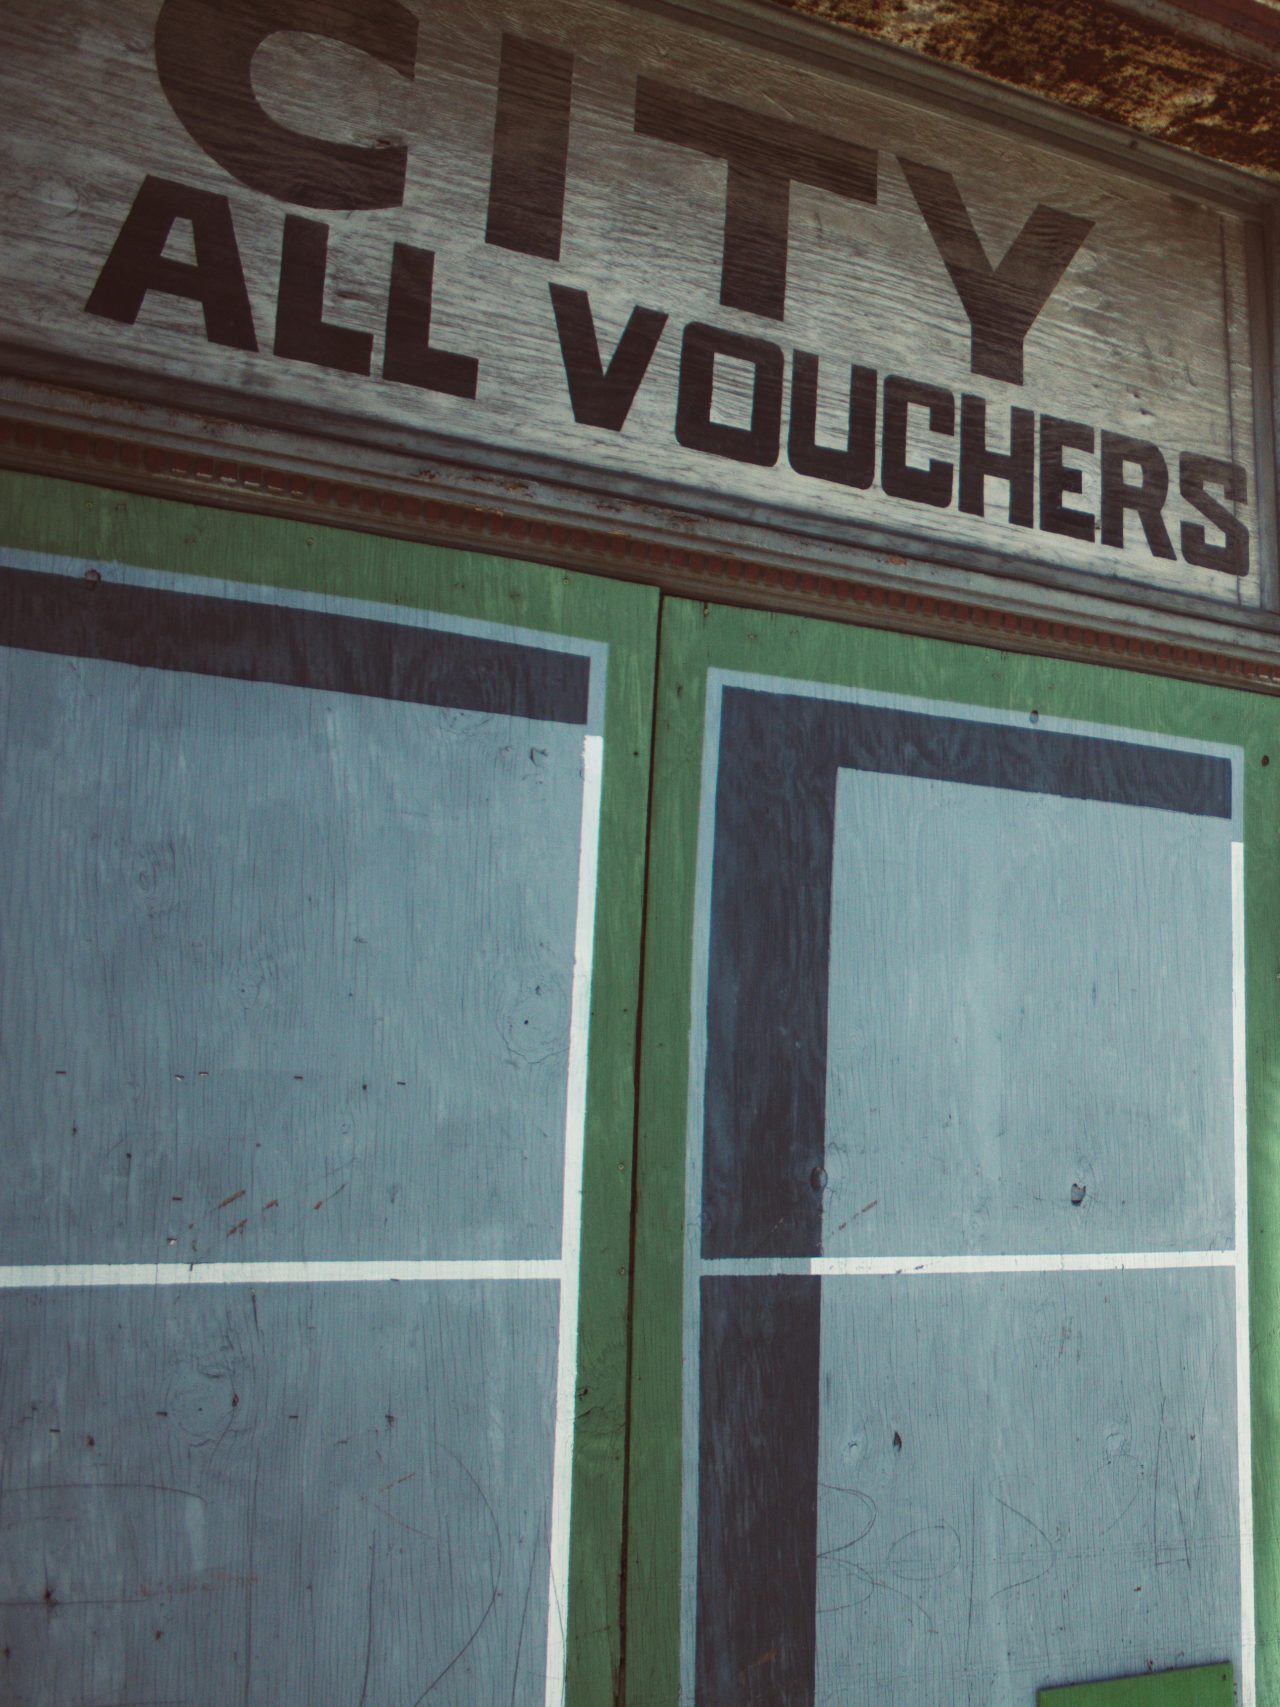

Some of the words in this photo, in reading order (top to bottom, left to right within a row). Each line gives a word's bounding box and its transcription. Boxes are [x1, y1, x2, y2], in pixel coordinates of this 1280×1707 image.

[84, 174, 480, 400] ALL
[548, 281, 1250, 577] VOUCHERS
[154, 0, 1096, 386] CITY
